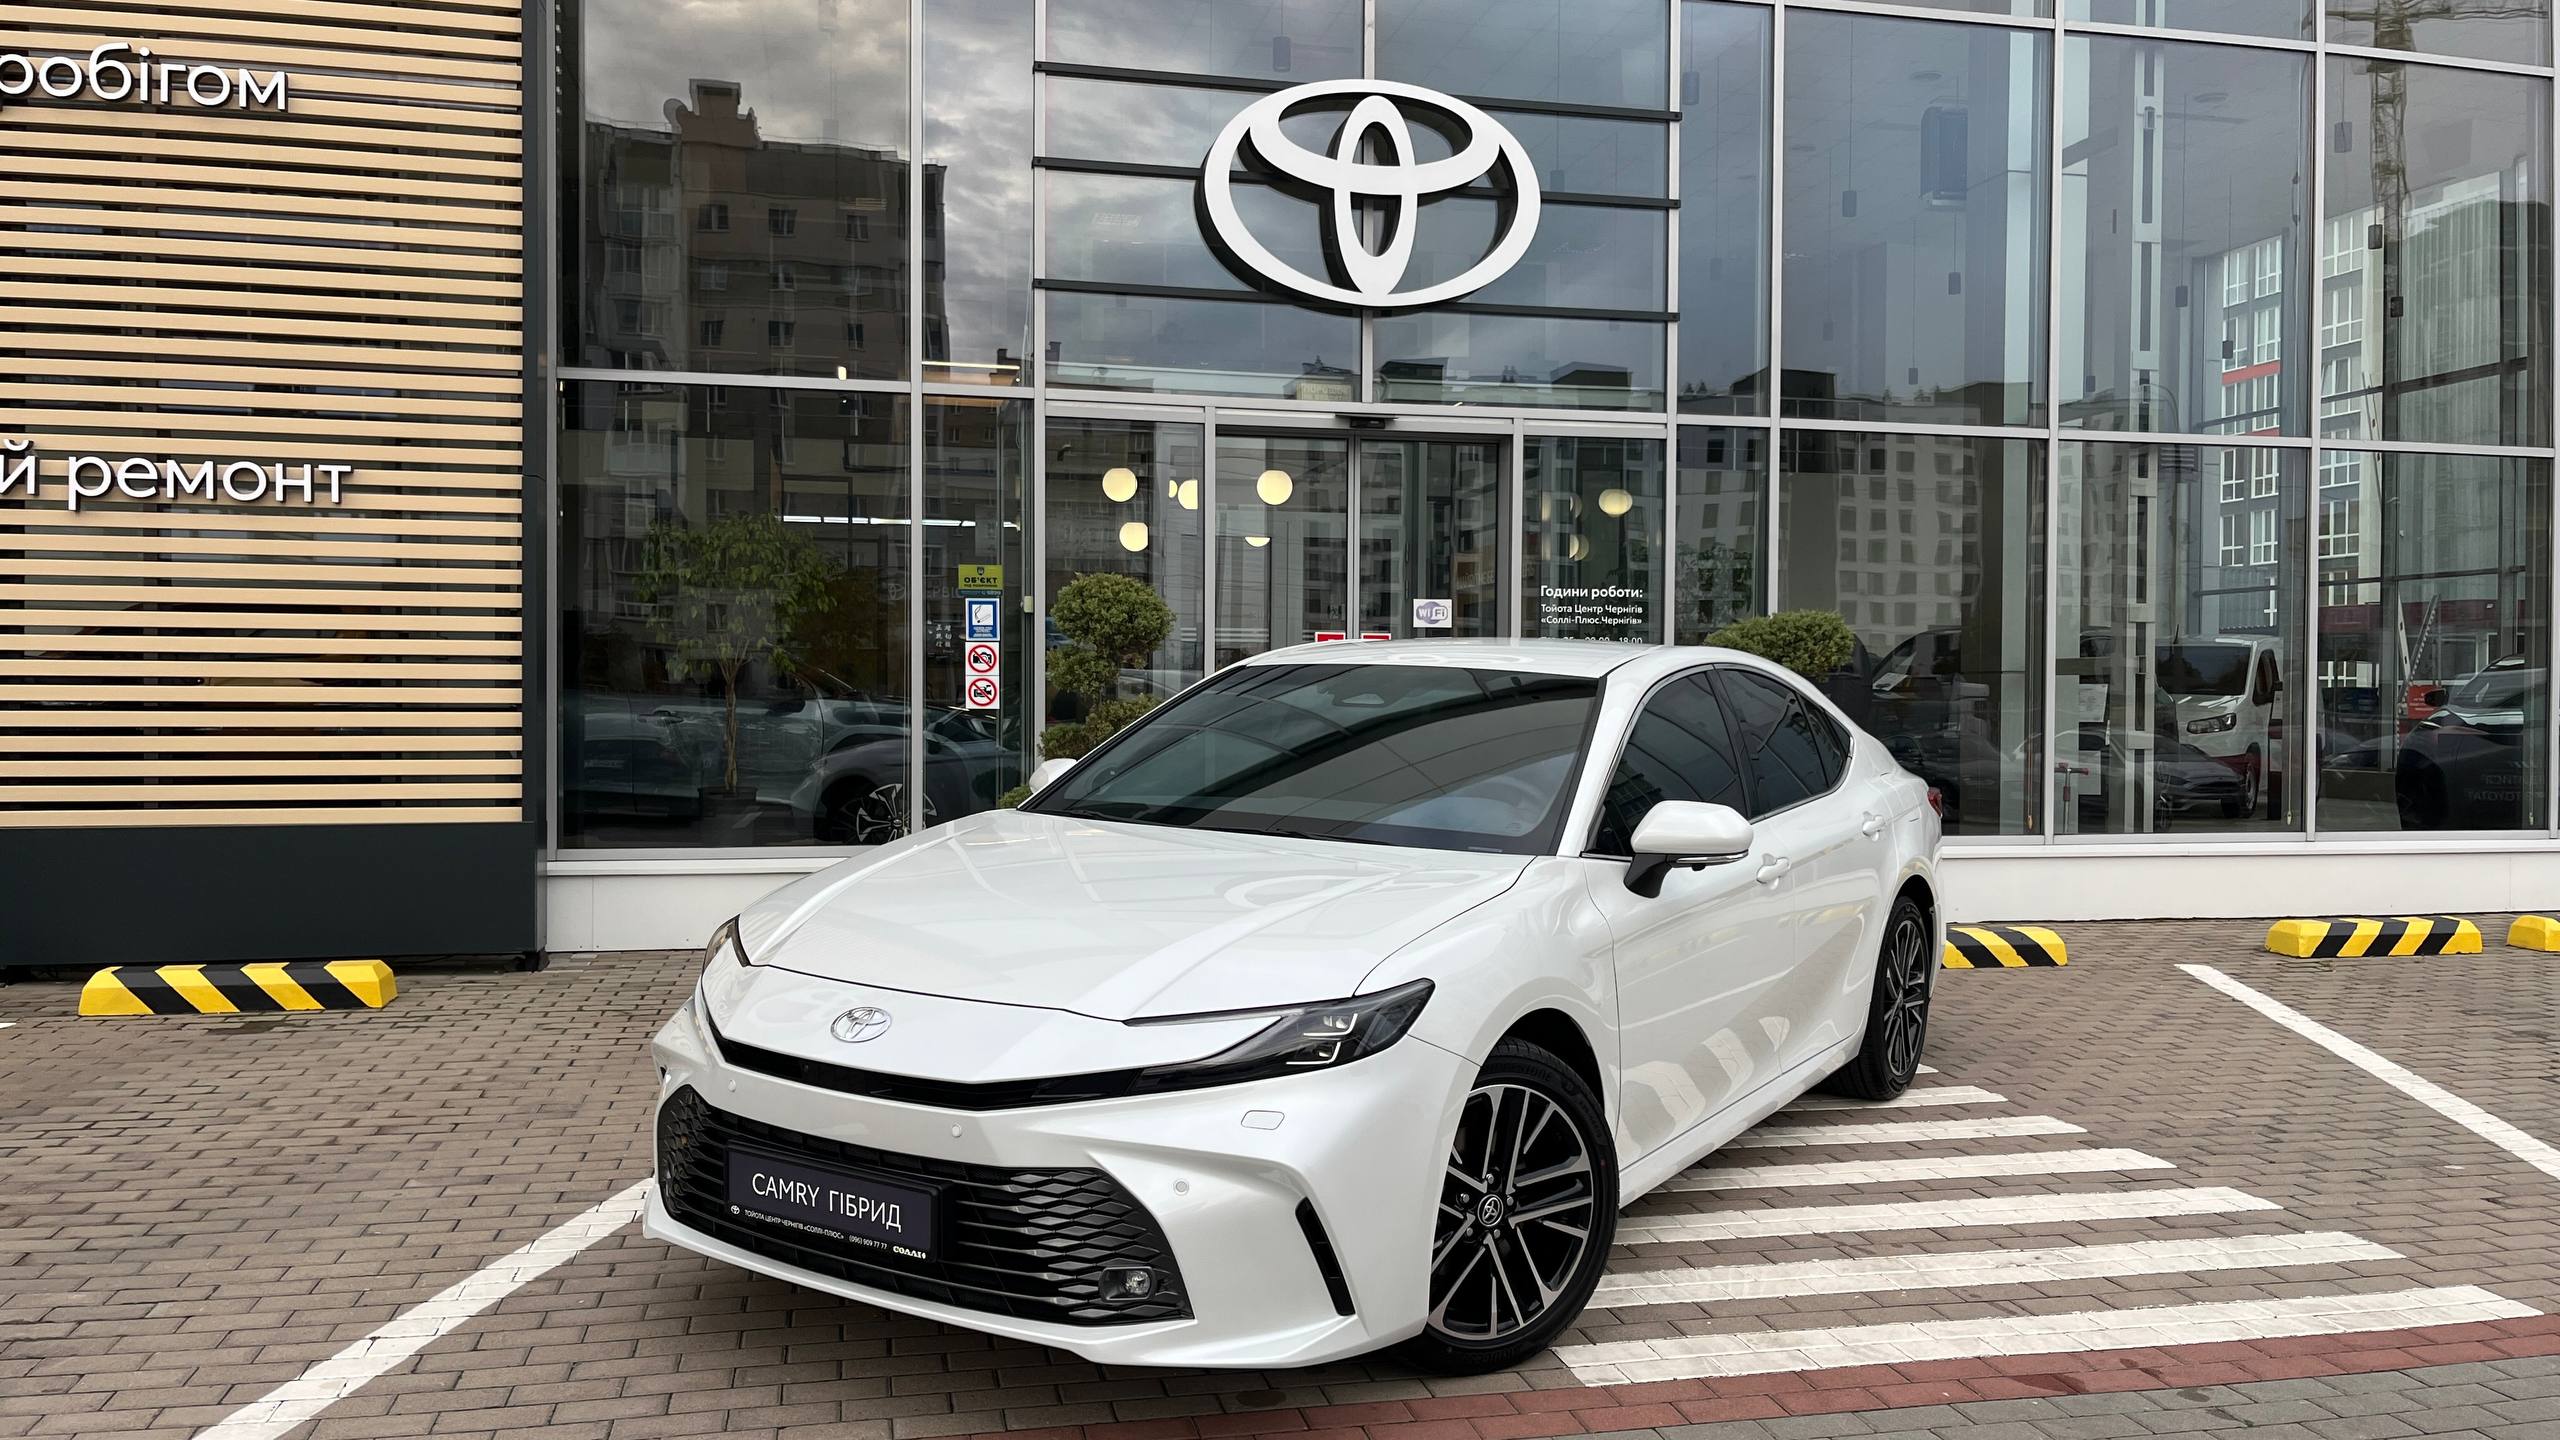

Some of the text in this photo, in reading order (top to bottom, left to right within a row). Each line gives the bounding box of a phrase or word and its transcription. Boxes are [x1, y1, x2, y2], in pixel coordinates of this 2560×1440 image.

[67, 455, 353, 511] ремонт
[1540, 585, 1643, 600] Години роботи:
[1541, 603, 1643, 615] Тойота Центр Чернігів
[752, 1172, 902, 1233] CAMRY ГІБРИД
